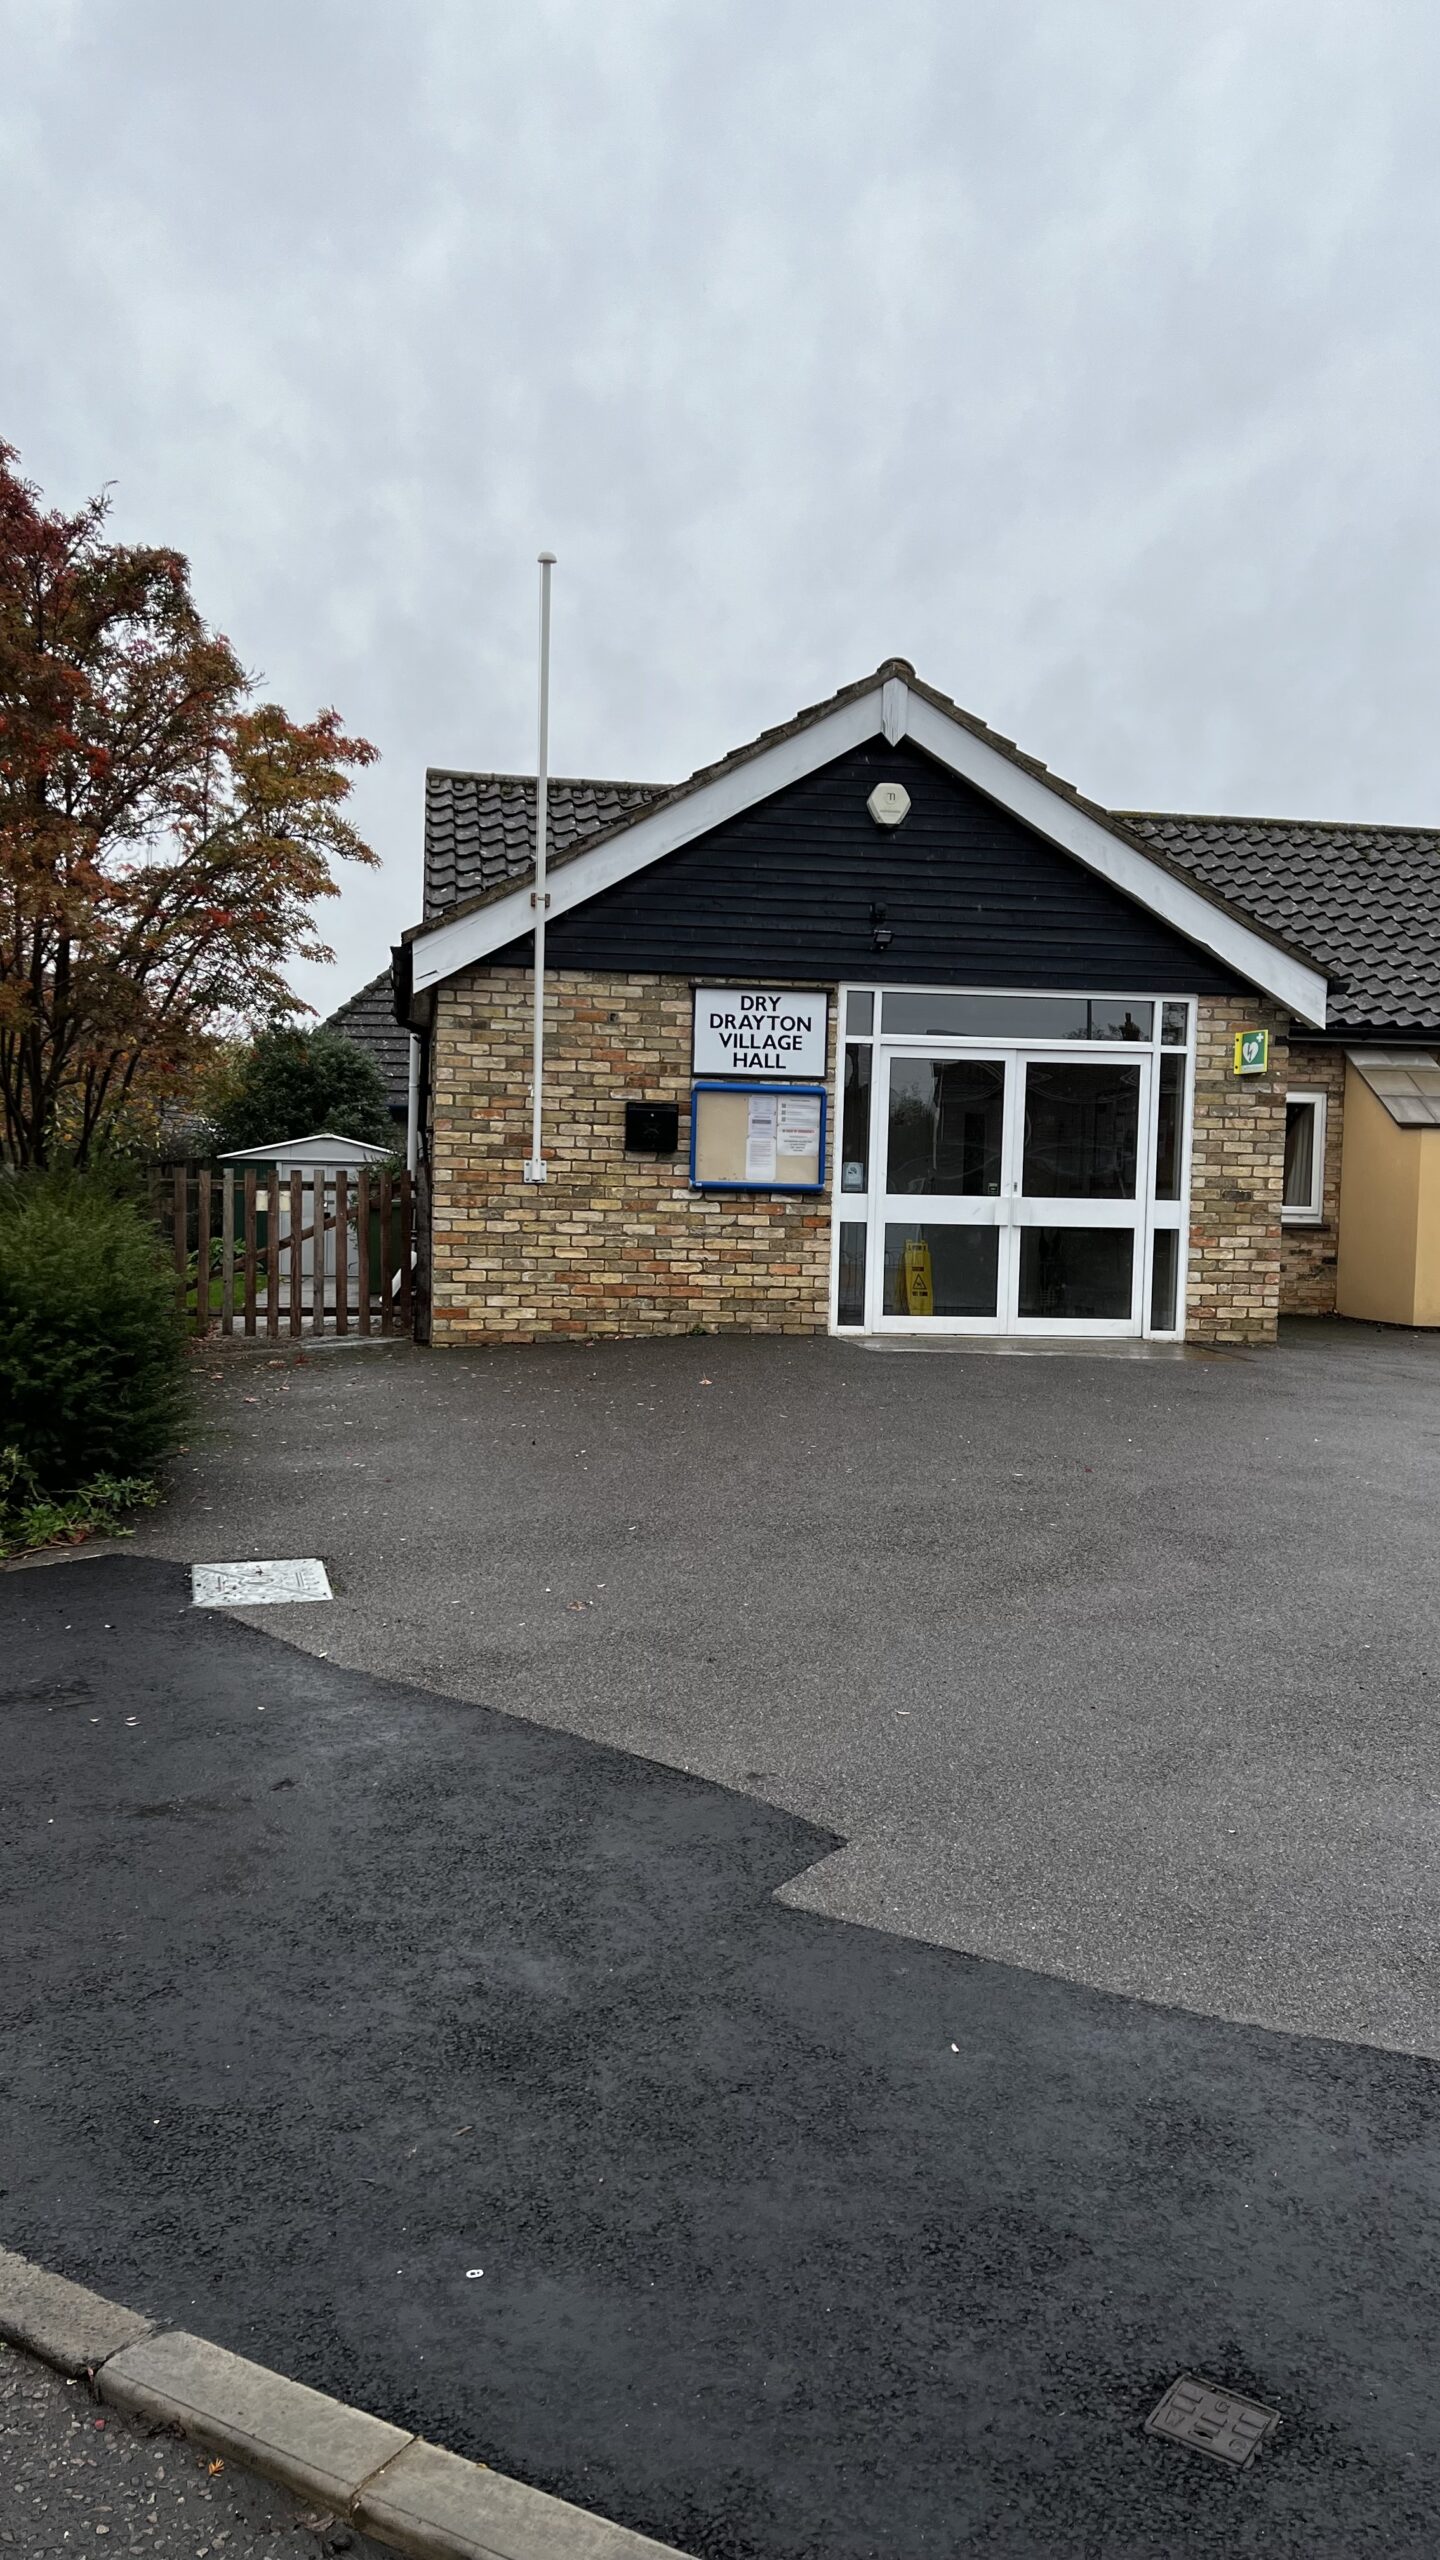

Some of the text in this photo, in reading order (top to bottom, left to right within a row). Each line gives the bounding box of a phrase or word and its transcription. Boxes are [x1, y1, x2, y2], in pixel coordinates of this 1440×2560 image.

[740, 995, 782, 1012] DRY
[709, 1013, 812, 1032] DRAYTON
[718, 1032, 803, 1051] VILLAGE
[732, 1052, 787, 1069] HALL
